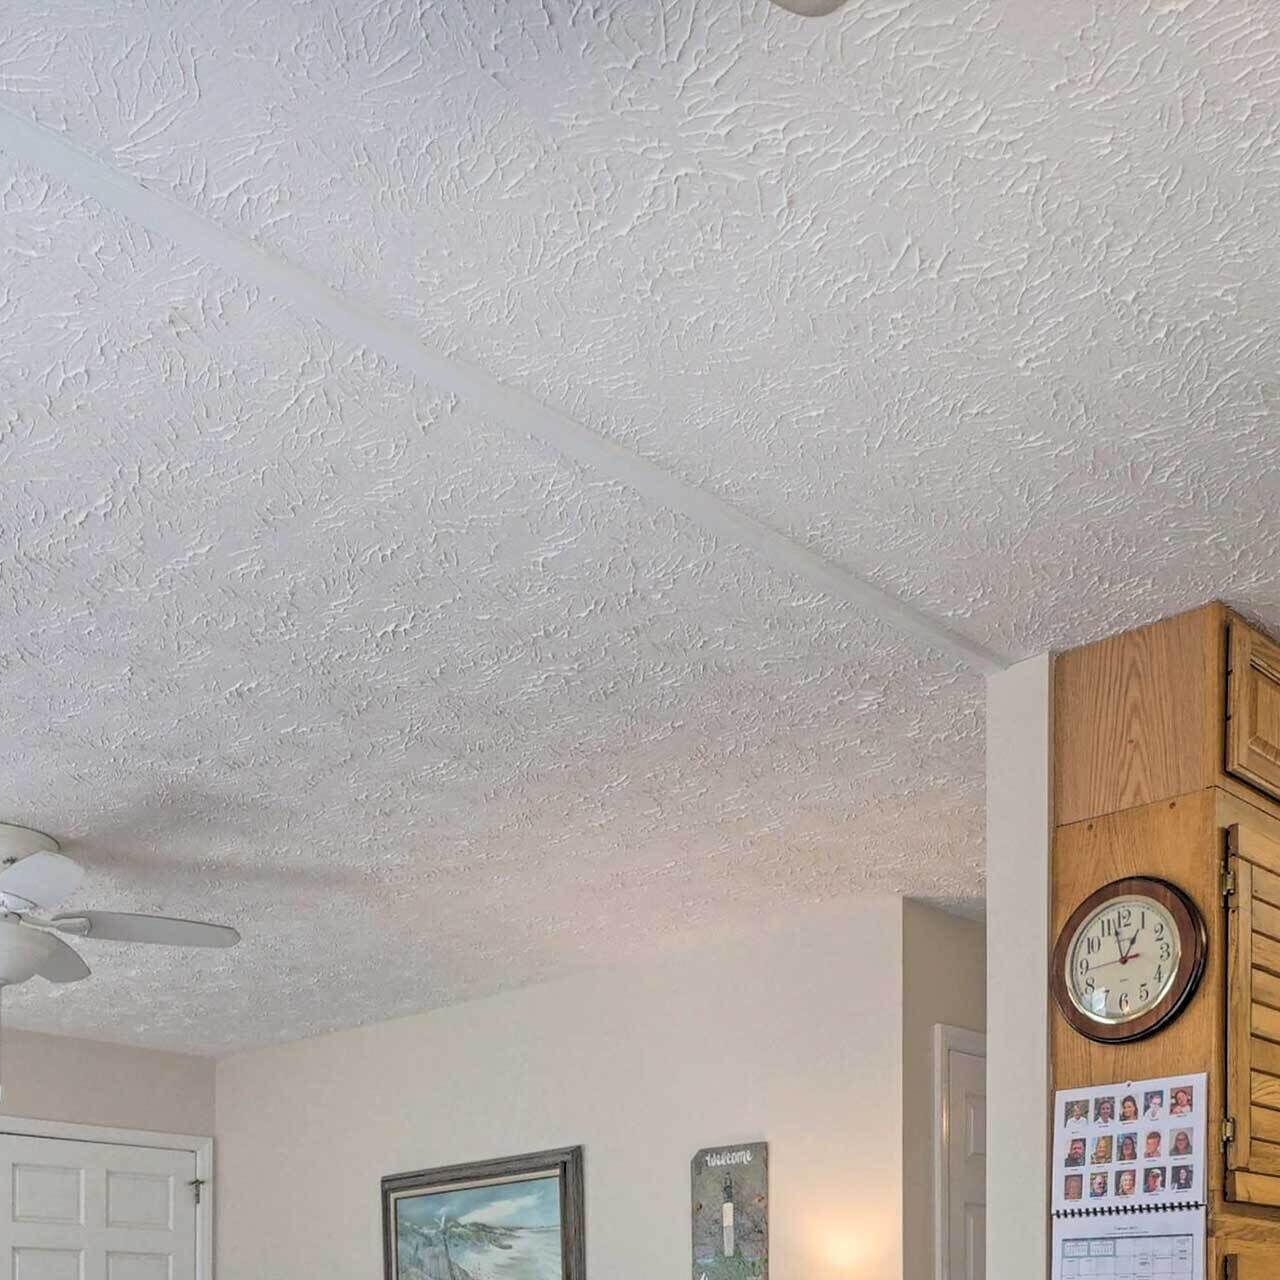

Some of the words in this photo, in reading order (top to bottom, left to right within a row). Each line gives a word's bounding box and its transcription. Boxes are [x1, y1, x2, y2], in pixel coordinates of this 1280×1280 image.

[1101, 918, 1111, 938] 11
[1117, 909, 1131, 928] 12
[1154, 923, 1164, 942] 2
[1087, 935, 1101, 954] 10
[1160, 942, 1170, 960] 3
[1079, 959, 1089, 976] 9
[1154, 964, 1164, 983] 4
[1085, 977, 1095, 995] 8
[1139, 983, 1149, 1001] 5
[1119, 992, 1128, 1011] 6
[705, 1150, 753, 1167] Welcome
